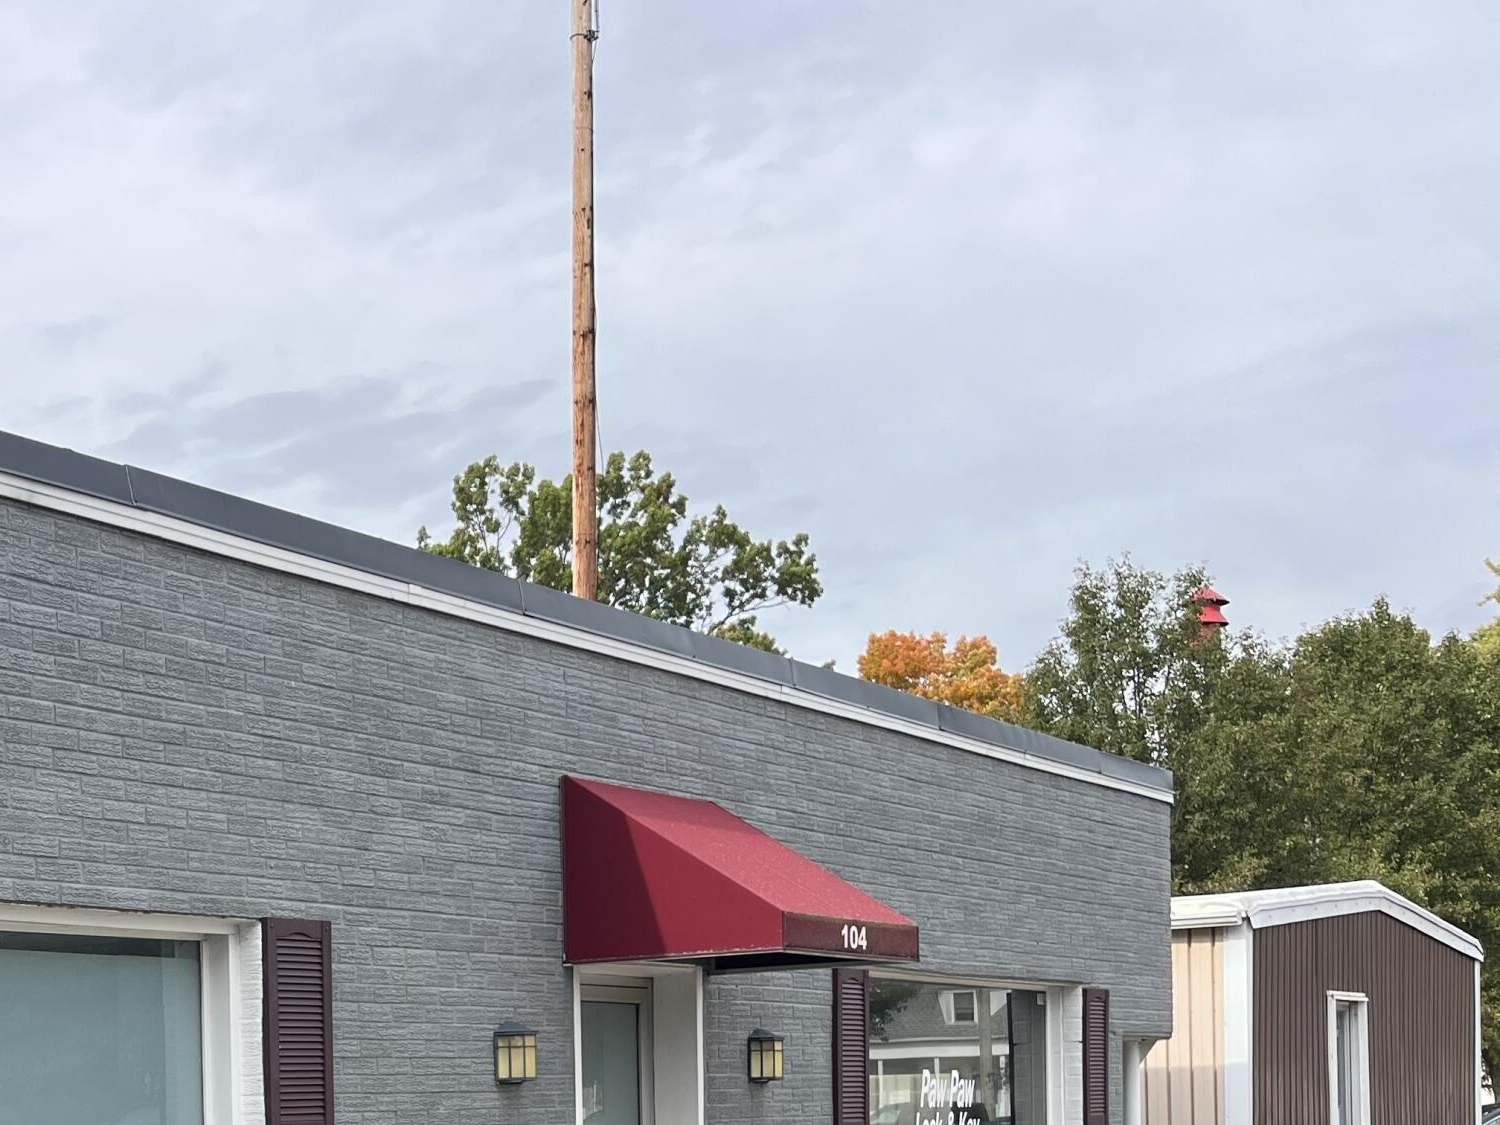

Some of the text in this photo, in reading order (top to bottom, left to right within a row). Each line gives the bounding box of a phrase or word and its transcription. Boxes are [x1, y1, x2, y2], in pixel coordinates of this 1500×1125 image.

[841, 924, 867, 950] 104
[920, 1069, 975, 1109] Paw Paw
